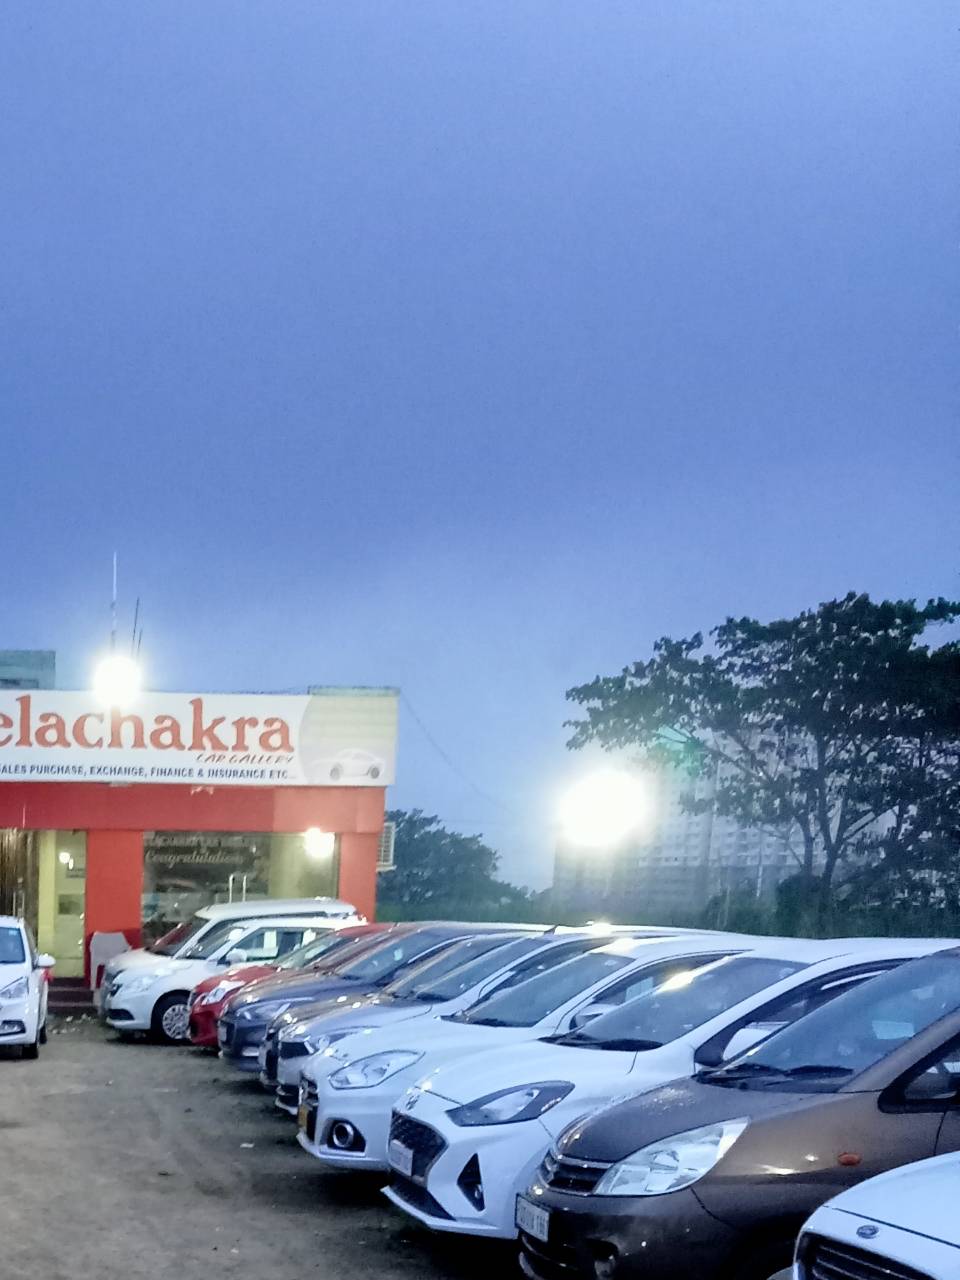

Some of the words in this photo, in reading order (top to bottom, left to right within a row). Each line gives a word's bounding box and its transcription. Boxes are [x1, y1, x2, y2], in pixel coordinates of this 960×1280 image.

[29, 764, 86, 776] PURCHASE,
[89, 765, 147, 777] EXCHANGE,
[150, 767, 193, 777] FINANCE
[197, 767, 204, 777] &
[208, 768, 265, 779] INSURANCE
